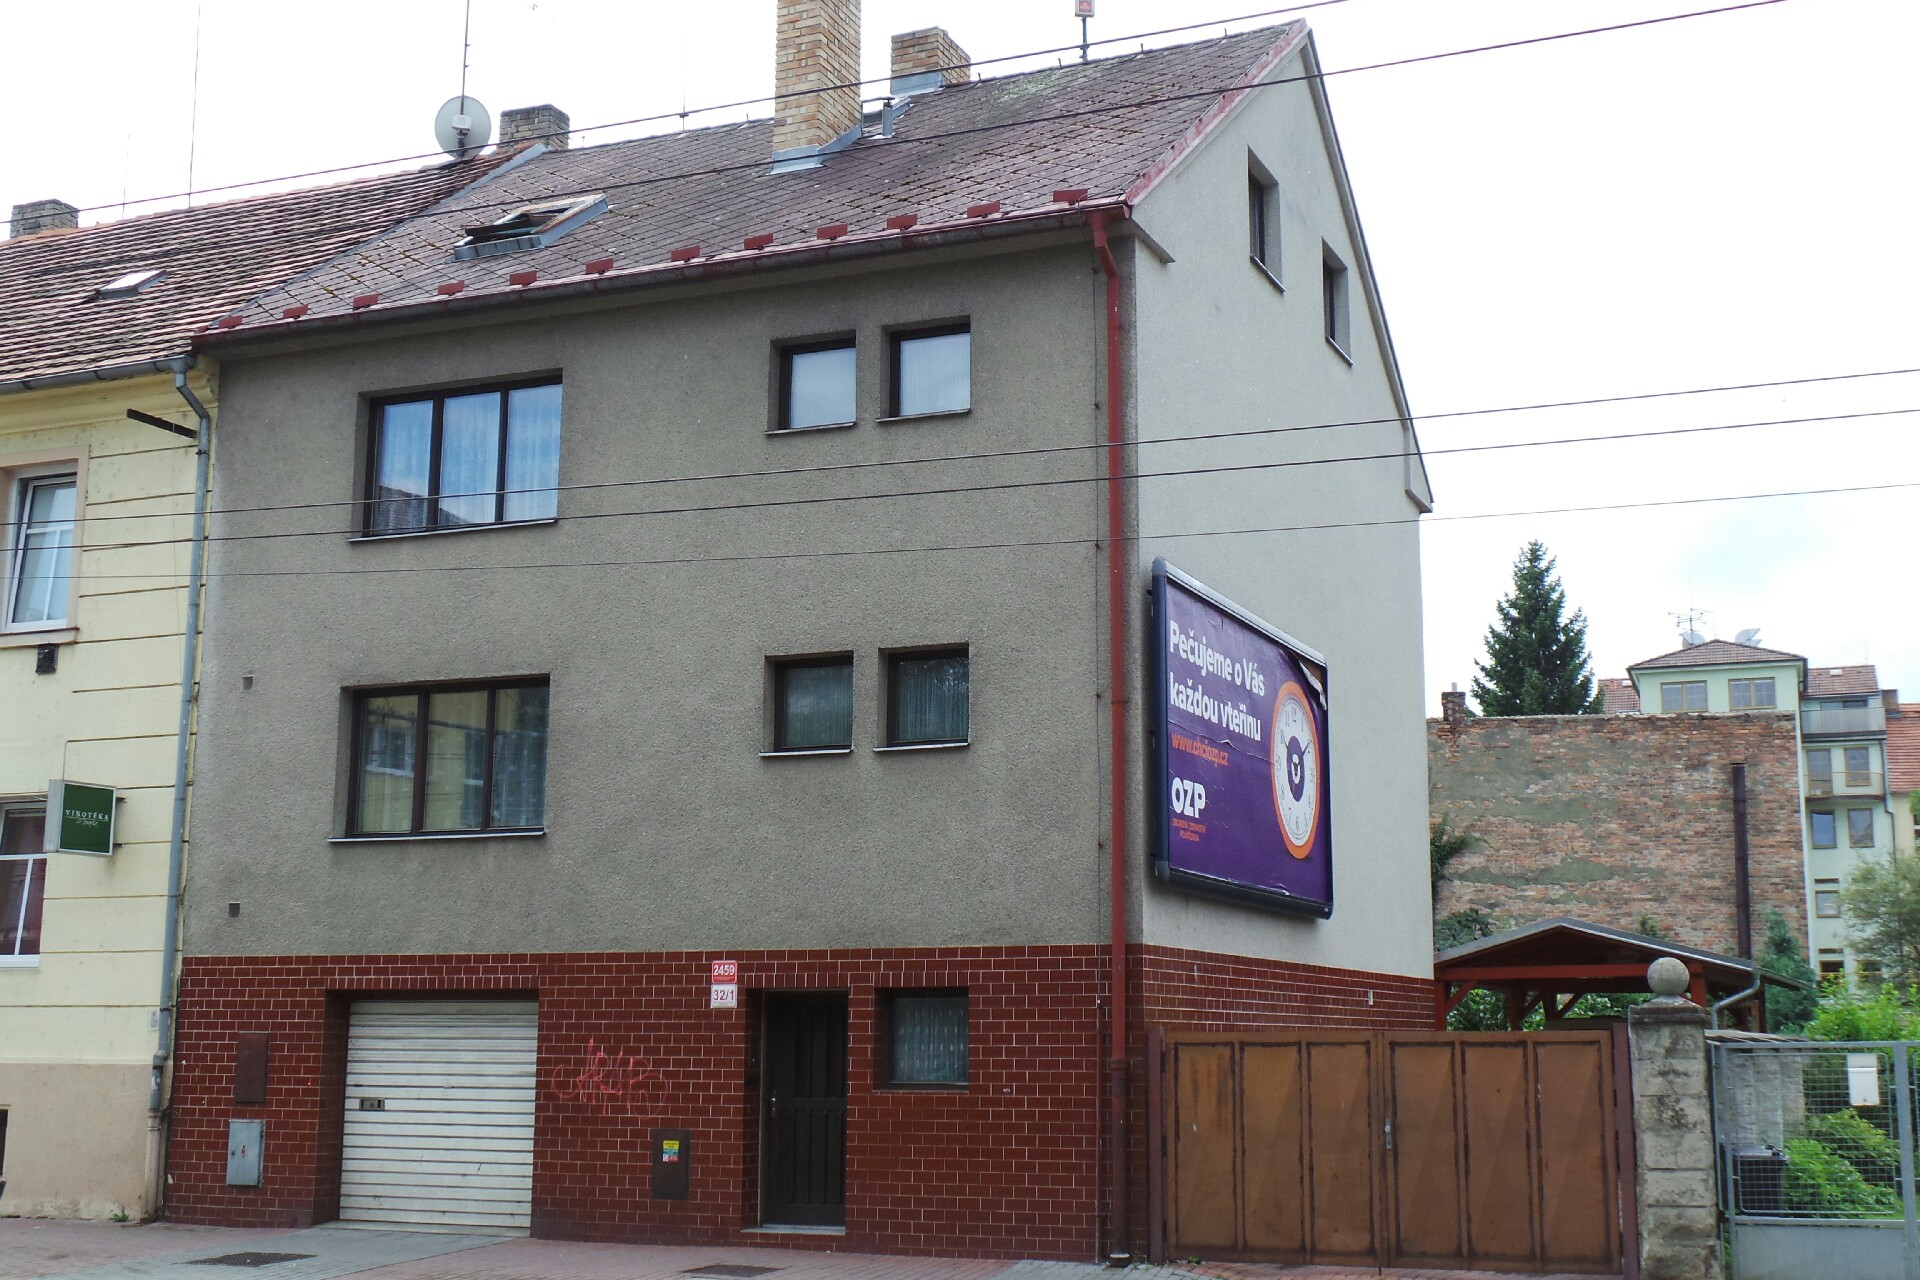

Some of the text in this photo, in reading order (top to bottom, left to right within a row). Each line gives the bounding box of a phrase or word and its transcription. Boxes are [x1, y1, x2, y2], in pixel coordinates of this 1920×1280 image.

[1170, 620, 1265, 697] Pečujeme o Vás
[1170, 671, 1261, 742] každou vteřinu
[1171, 776, 1206, 819] OZP
[713, 964, 735, 976] 2459
[713, 989, 734, 1001] 32/1
